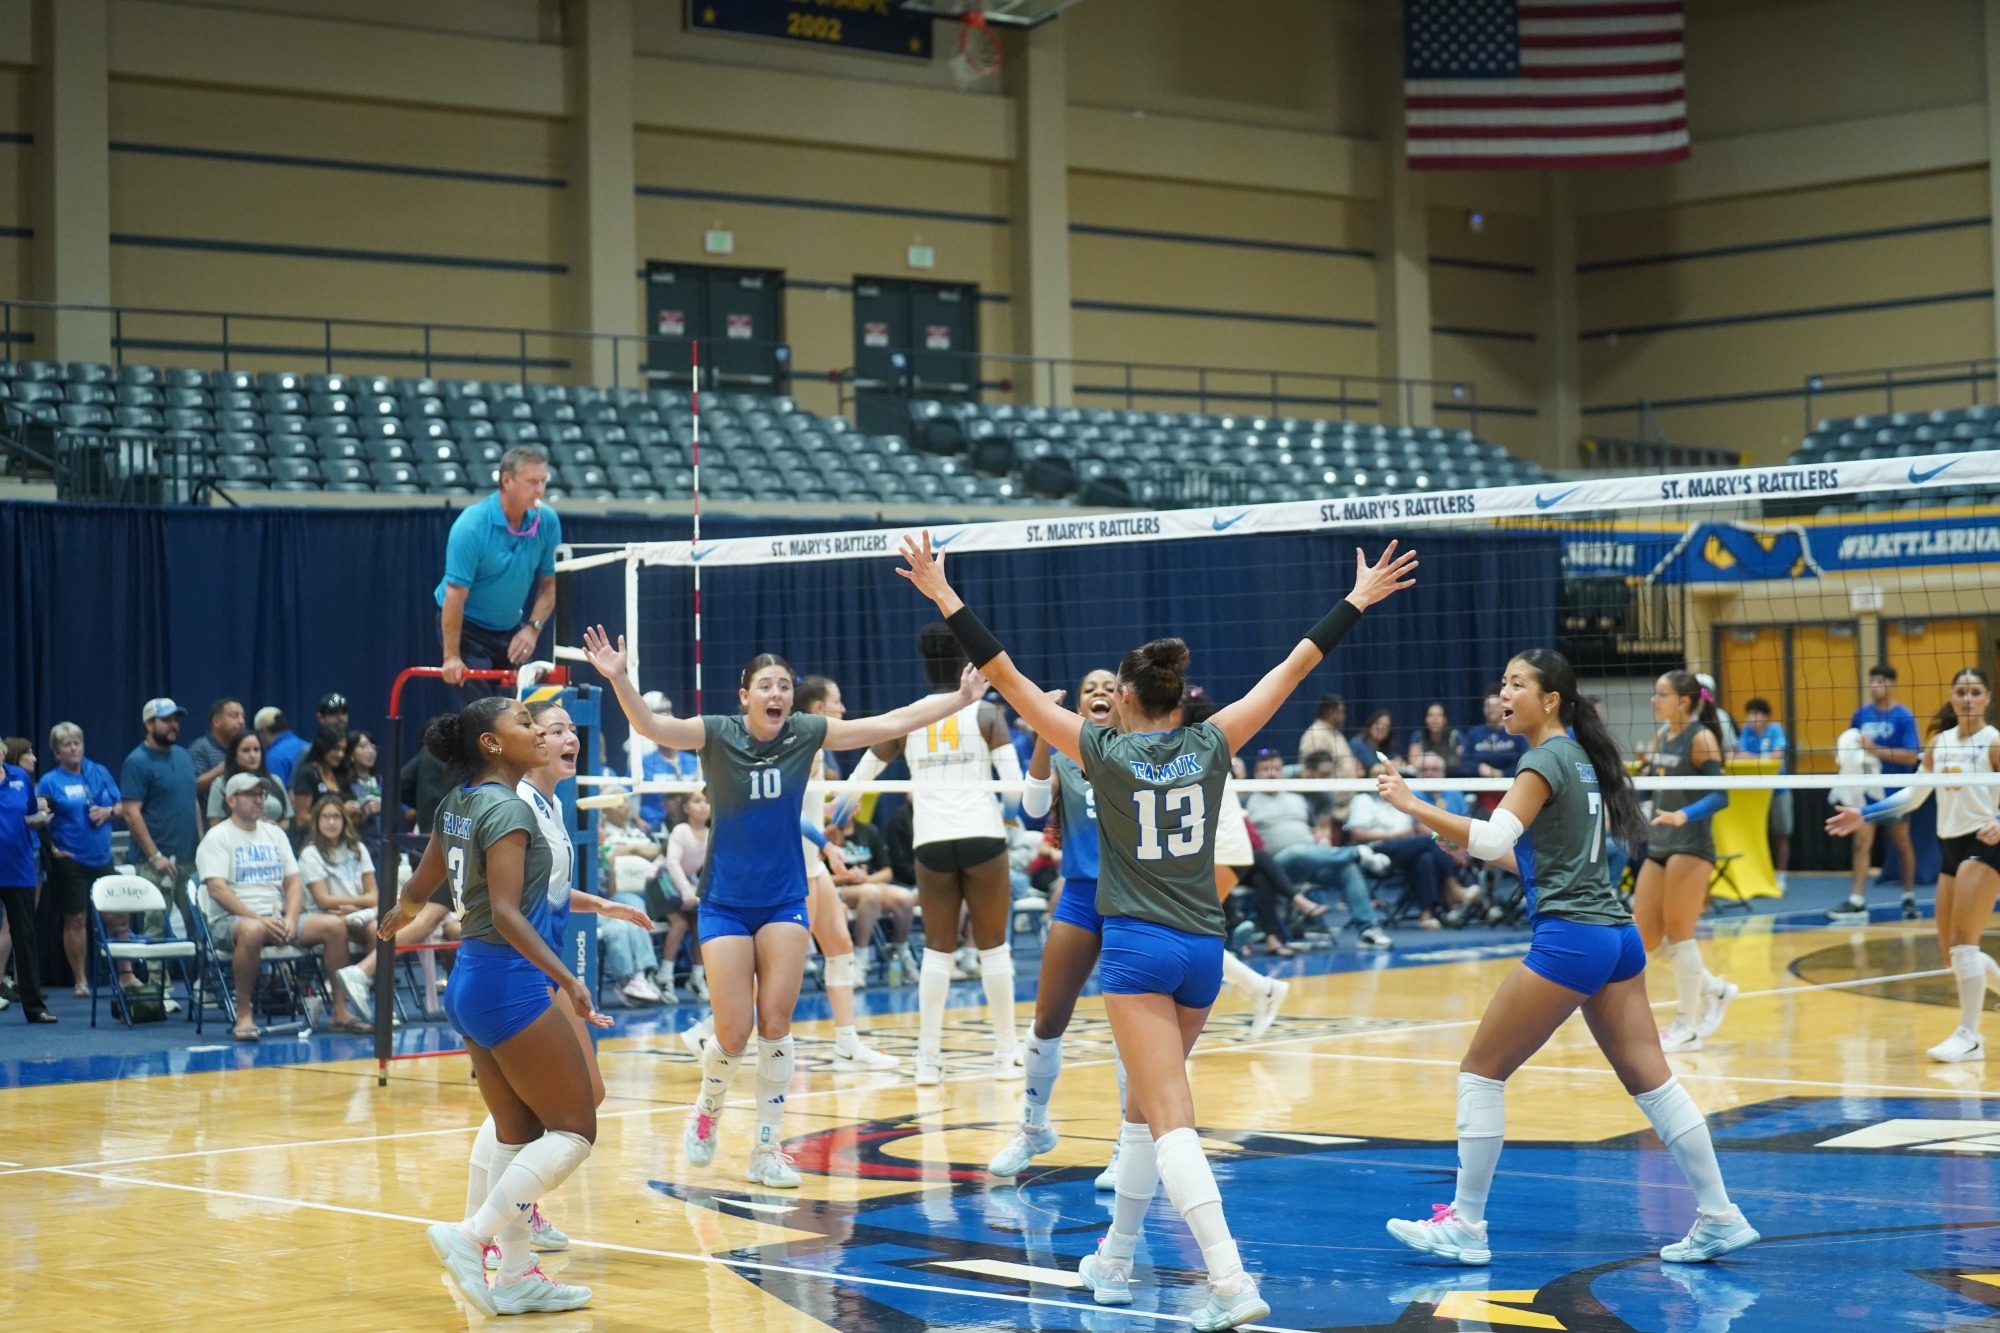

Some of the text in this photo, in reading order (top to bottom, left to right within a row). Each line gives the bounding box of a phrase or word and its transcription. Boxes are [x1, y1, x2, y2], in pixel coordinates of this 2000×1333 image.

[787, 12, 842, 41] 2002
[1660, 469, 1838, 500] ST. MARY'S RATTLERS
[1320, 494, 1475, 523] ST. MARY'S RATTLERS
[1026, 517, 1161, 542] ST. MARY'S RATTLERS
[771, 534, 887, 557] ST. MARY'S RATTLERS
[927, 715, 960, 752] 14
[1129, 752, 1203, 783] TAMUK
[749, 768, 782, 800] 10
[1132, 783, 1206, 861] 13
[1587, 792, 1602, 863] 7
[235, 864, 283, 882] UNIVERSITY
[447, 846, 466, 920] 3
[575, 930, 587, 976] sports
